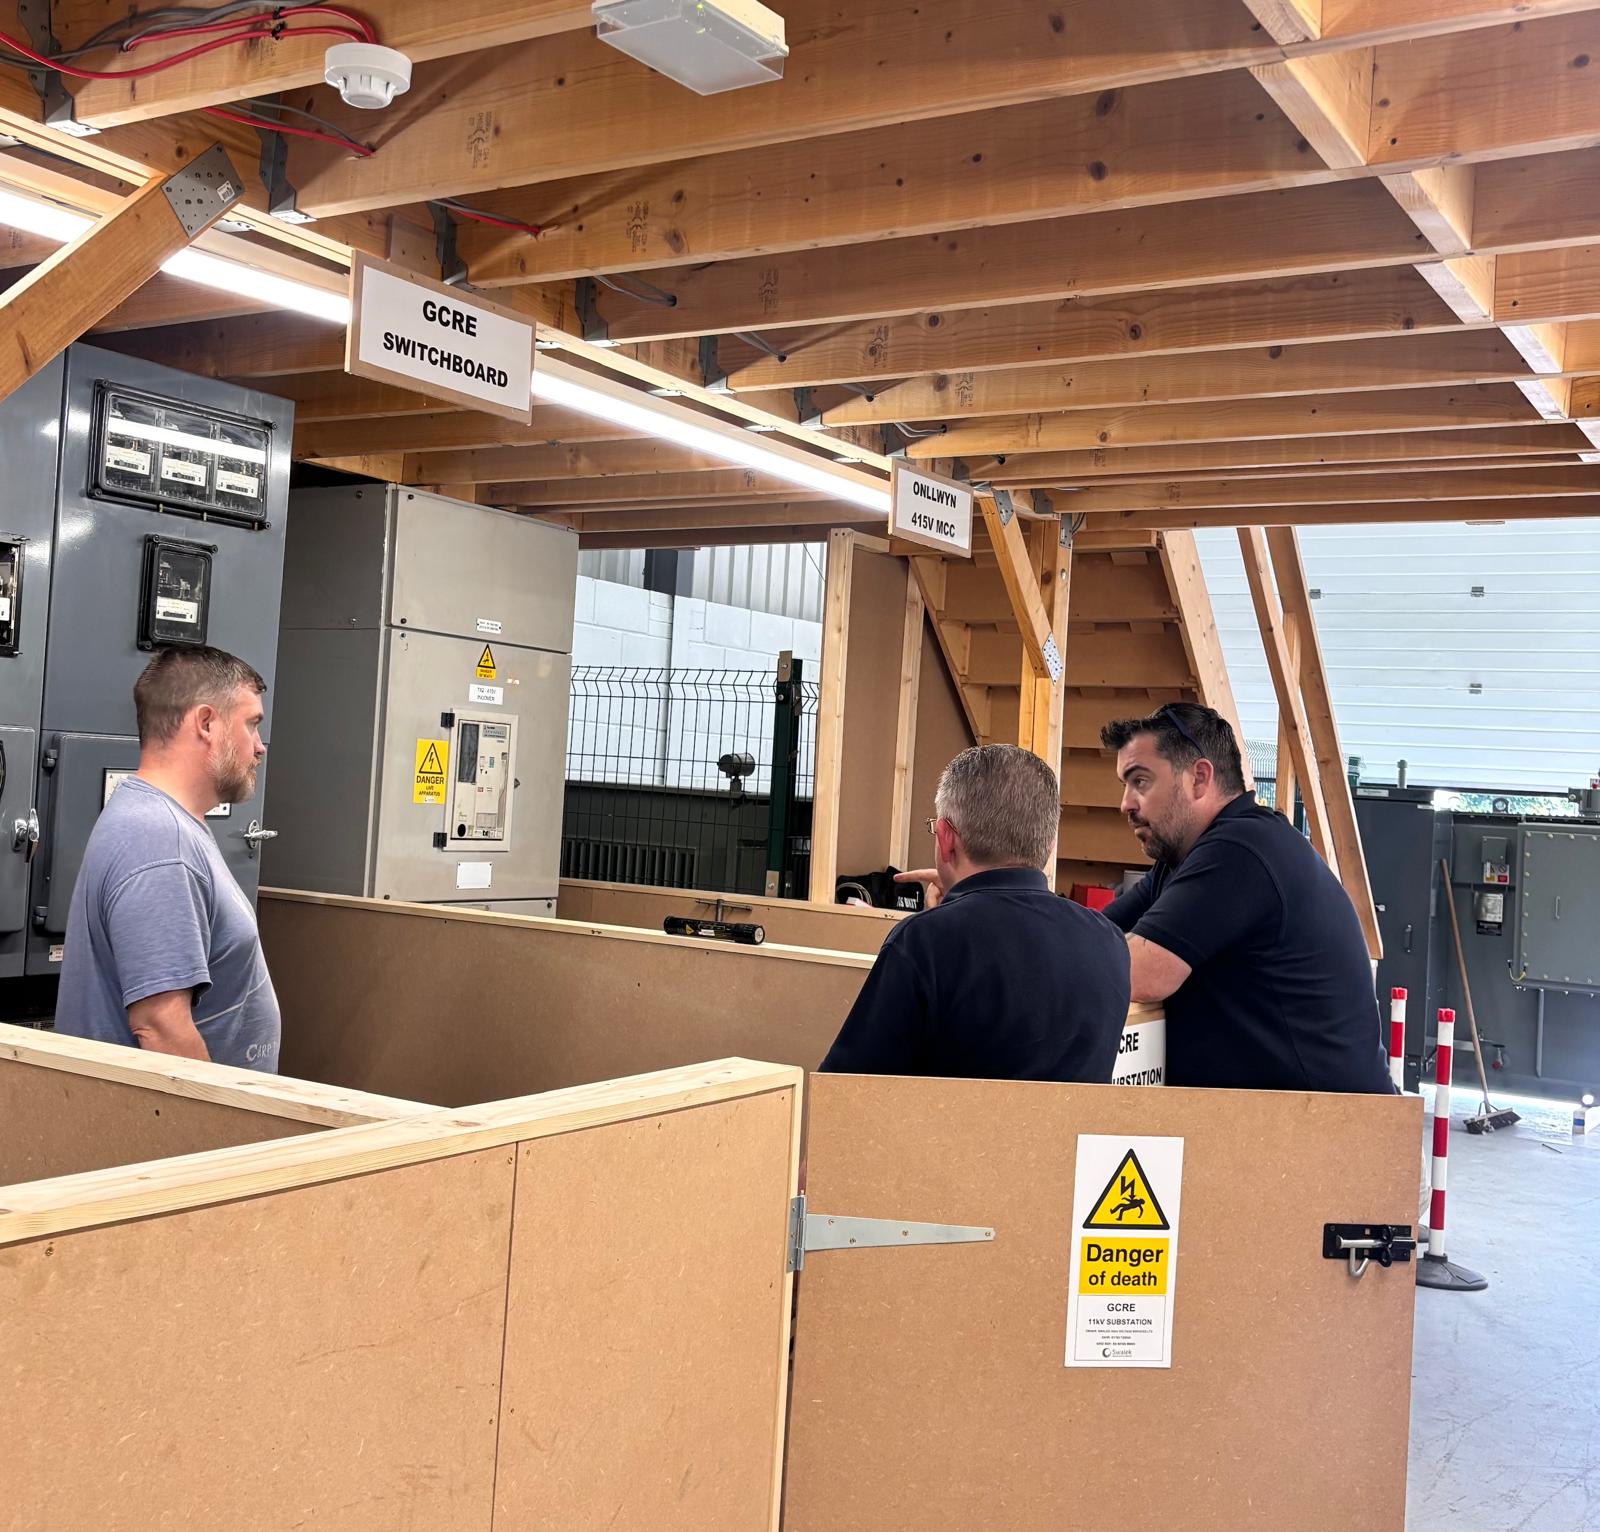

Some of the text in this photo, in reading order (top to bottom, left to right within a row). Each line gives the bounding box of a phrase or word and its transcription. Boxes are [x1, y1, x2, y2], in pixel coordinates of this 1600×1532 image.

[422, 300, 477, 337] GCRE
[383, 332, 508, 388] SWITCHBOARD
[913, 481, 957, 508] ONLLWYN
[911, 512, 956, 538] 415V MCC
[416, 775, 445, 785] DANGER
[1118, 1032, 1139, 1054] CRE
[1087, 1244, 1164, 1267] Danger
[1088, 1270, 1157, 1286] of death
[1107, 1303, 1136, 1312] GCRE
